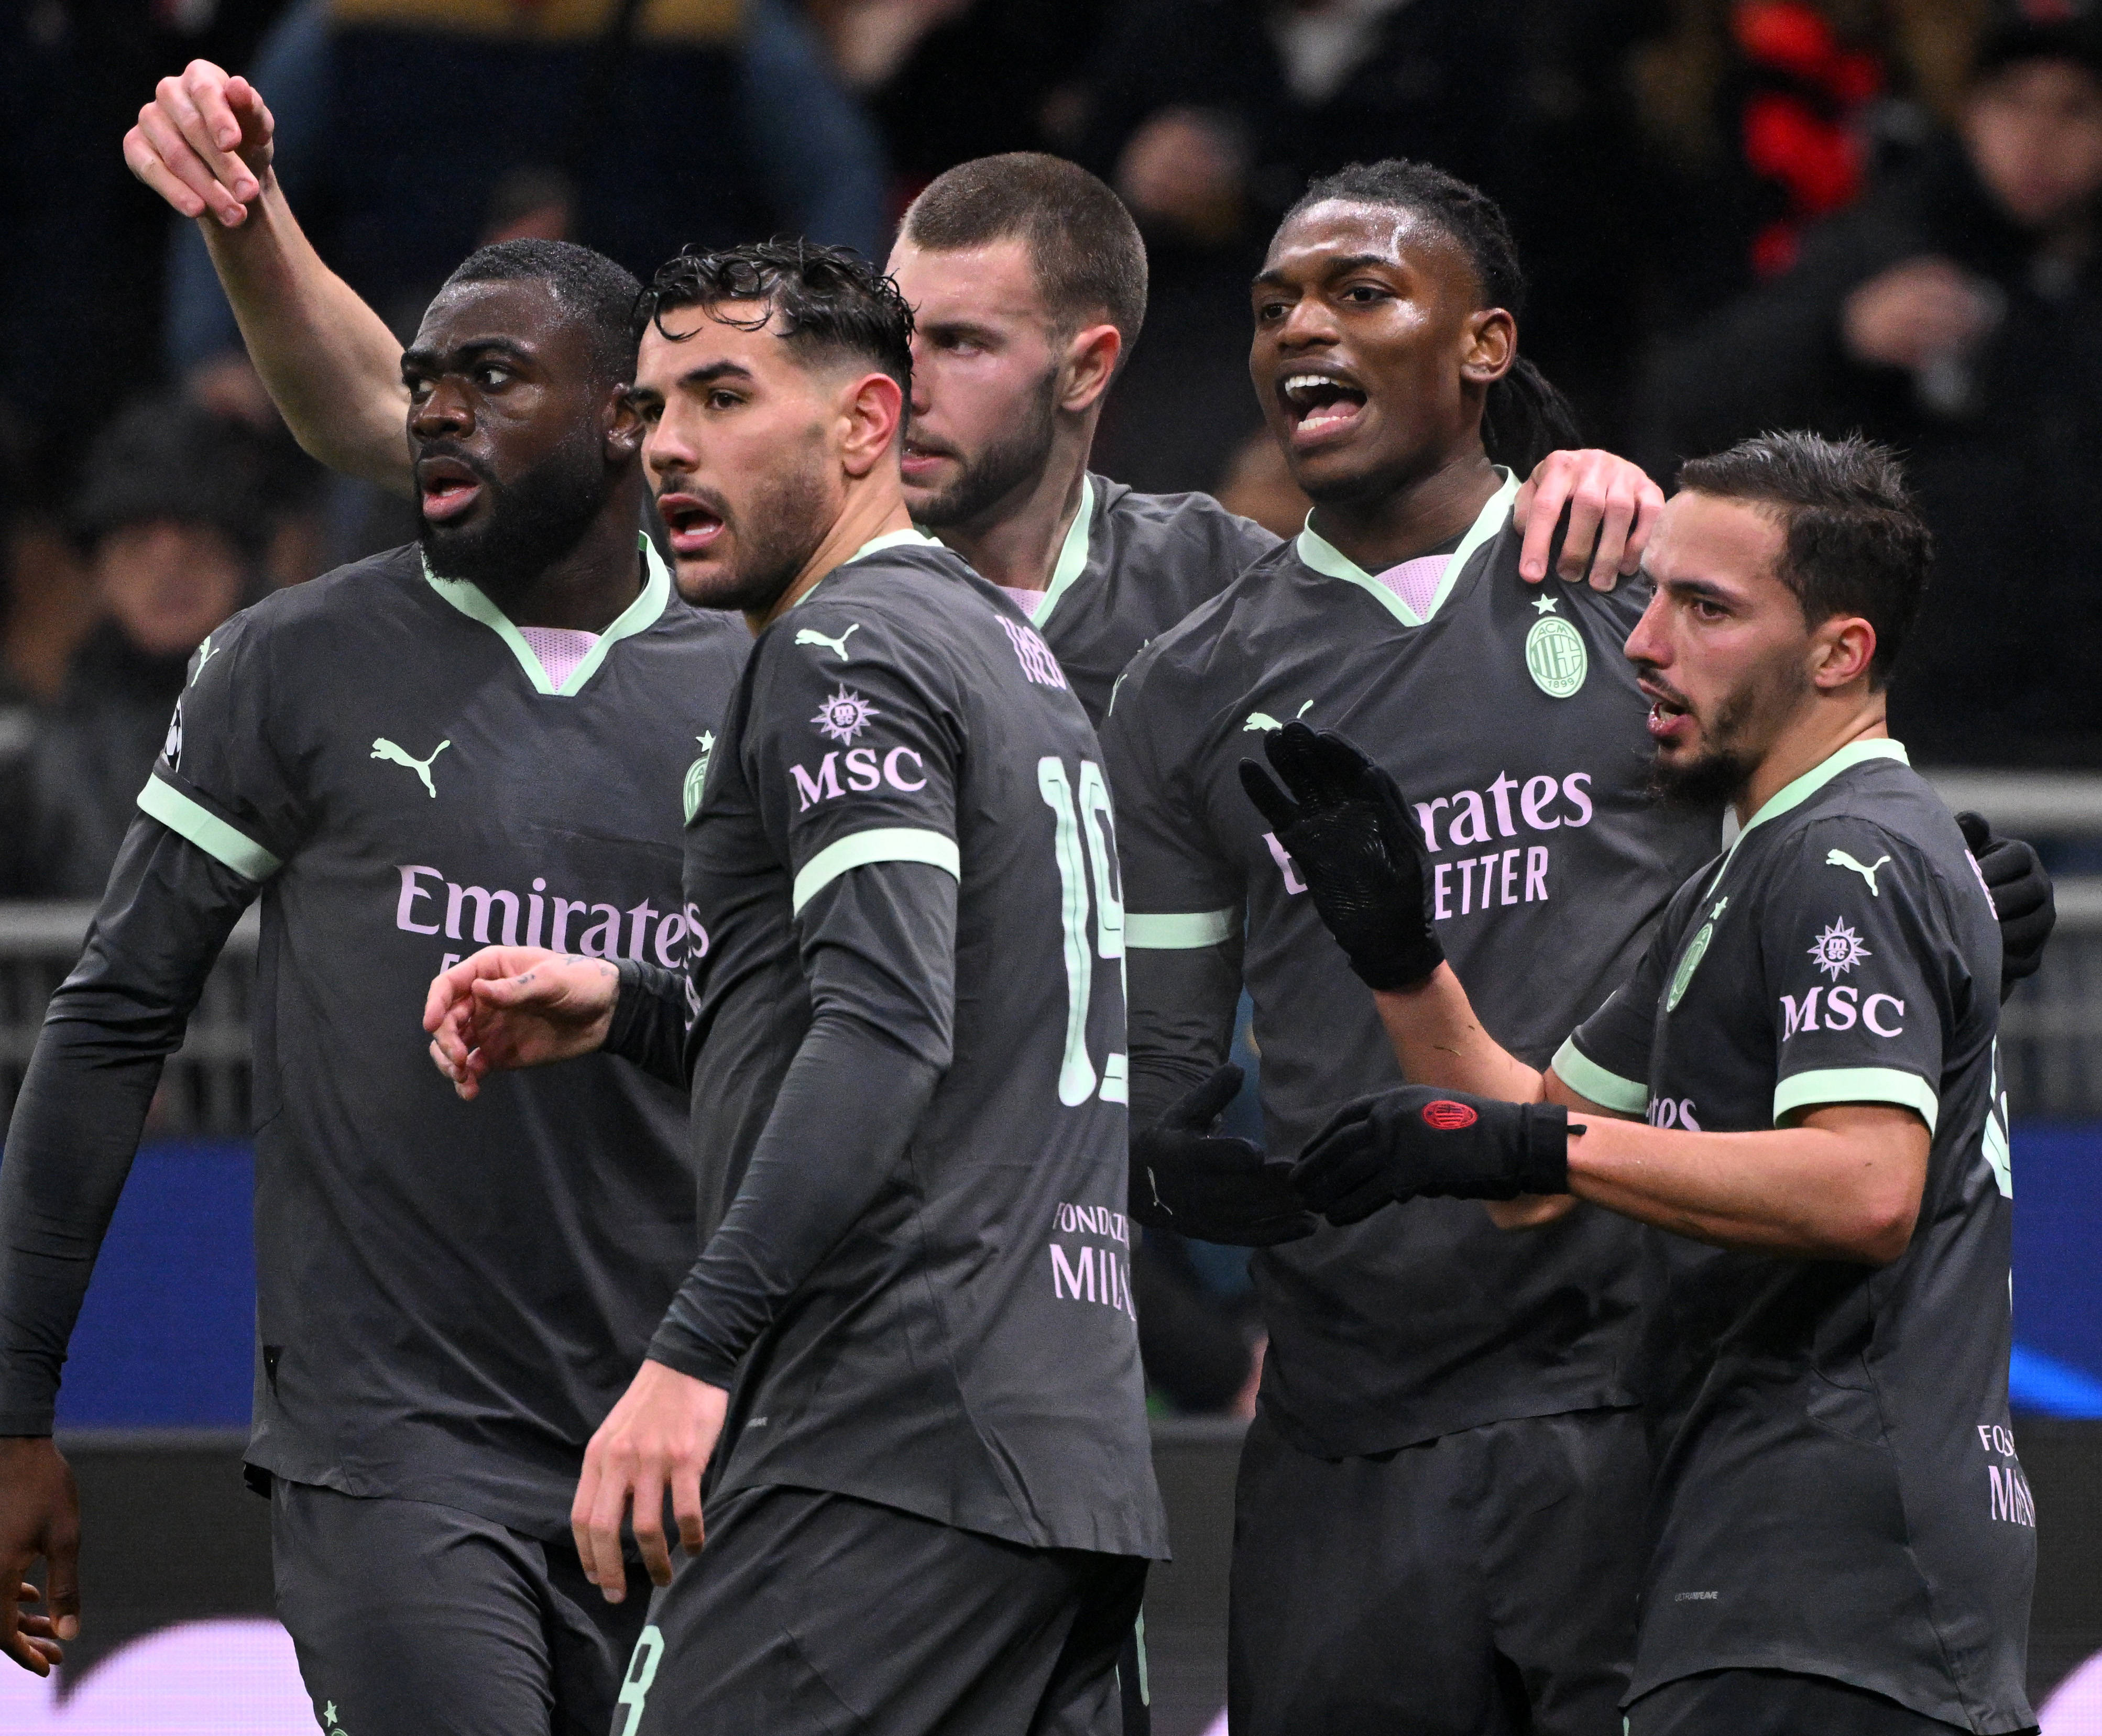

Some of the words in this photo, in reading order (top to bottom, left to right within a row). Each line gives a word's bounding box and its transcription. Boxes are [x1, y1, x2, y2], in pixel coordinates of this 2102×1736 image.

[1536, 623, 1568, 640] ACM
[1548, 678, 1575, 688] 1899
[789, 746, 927, 813] MSC
[1435, 845, 1549, 920] ETTER
[393, 864, 709, 968] Emirates
[1780, 986, 1904, 1041] MSC
